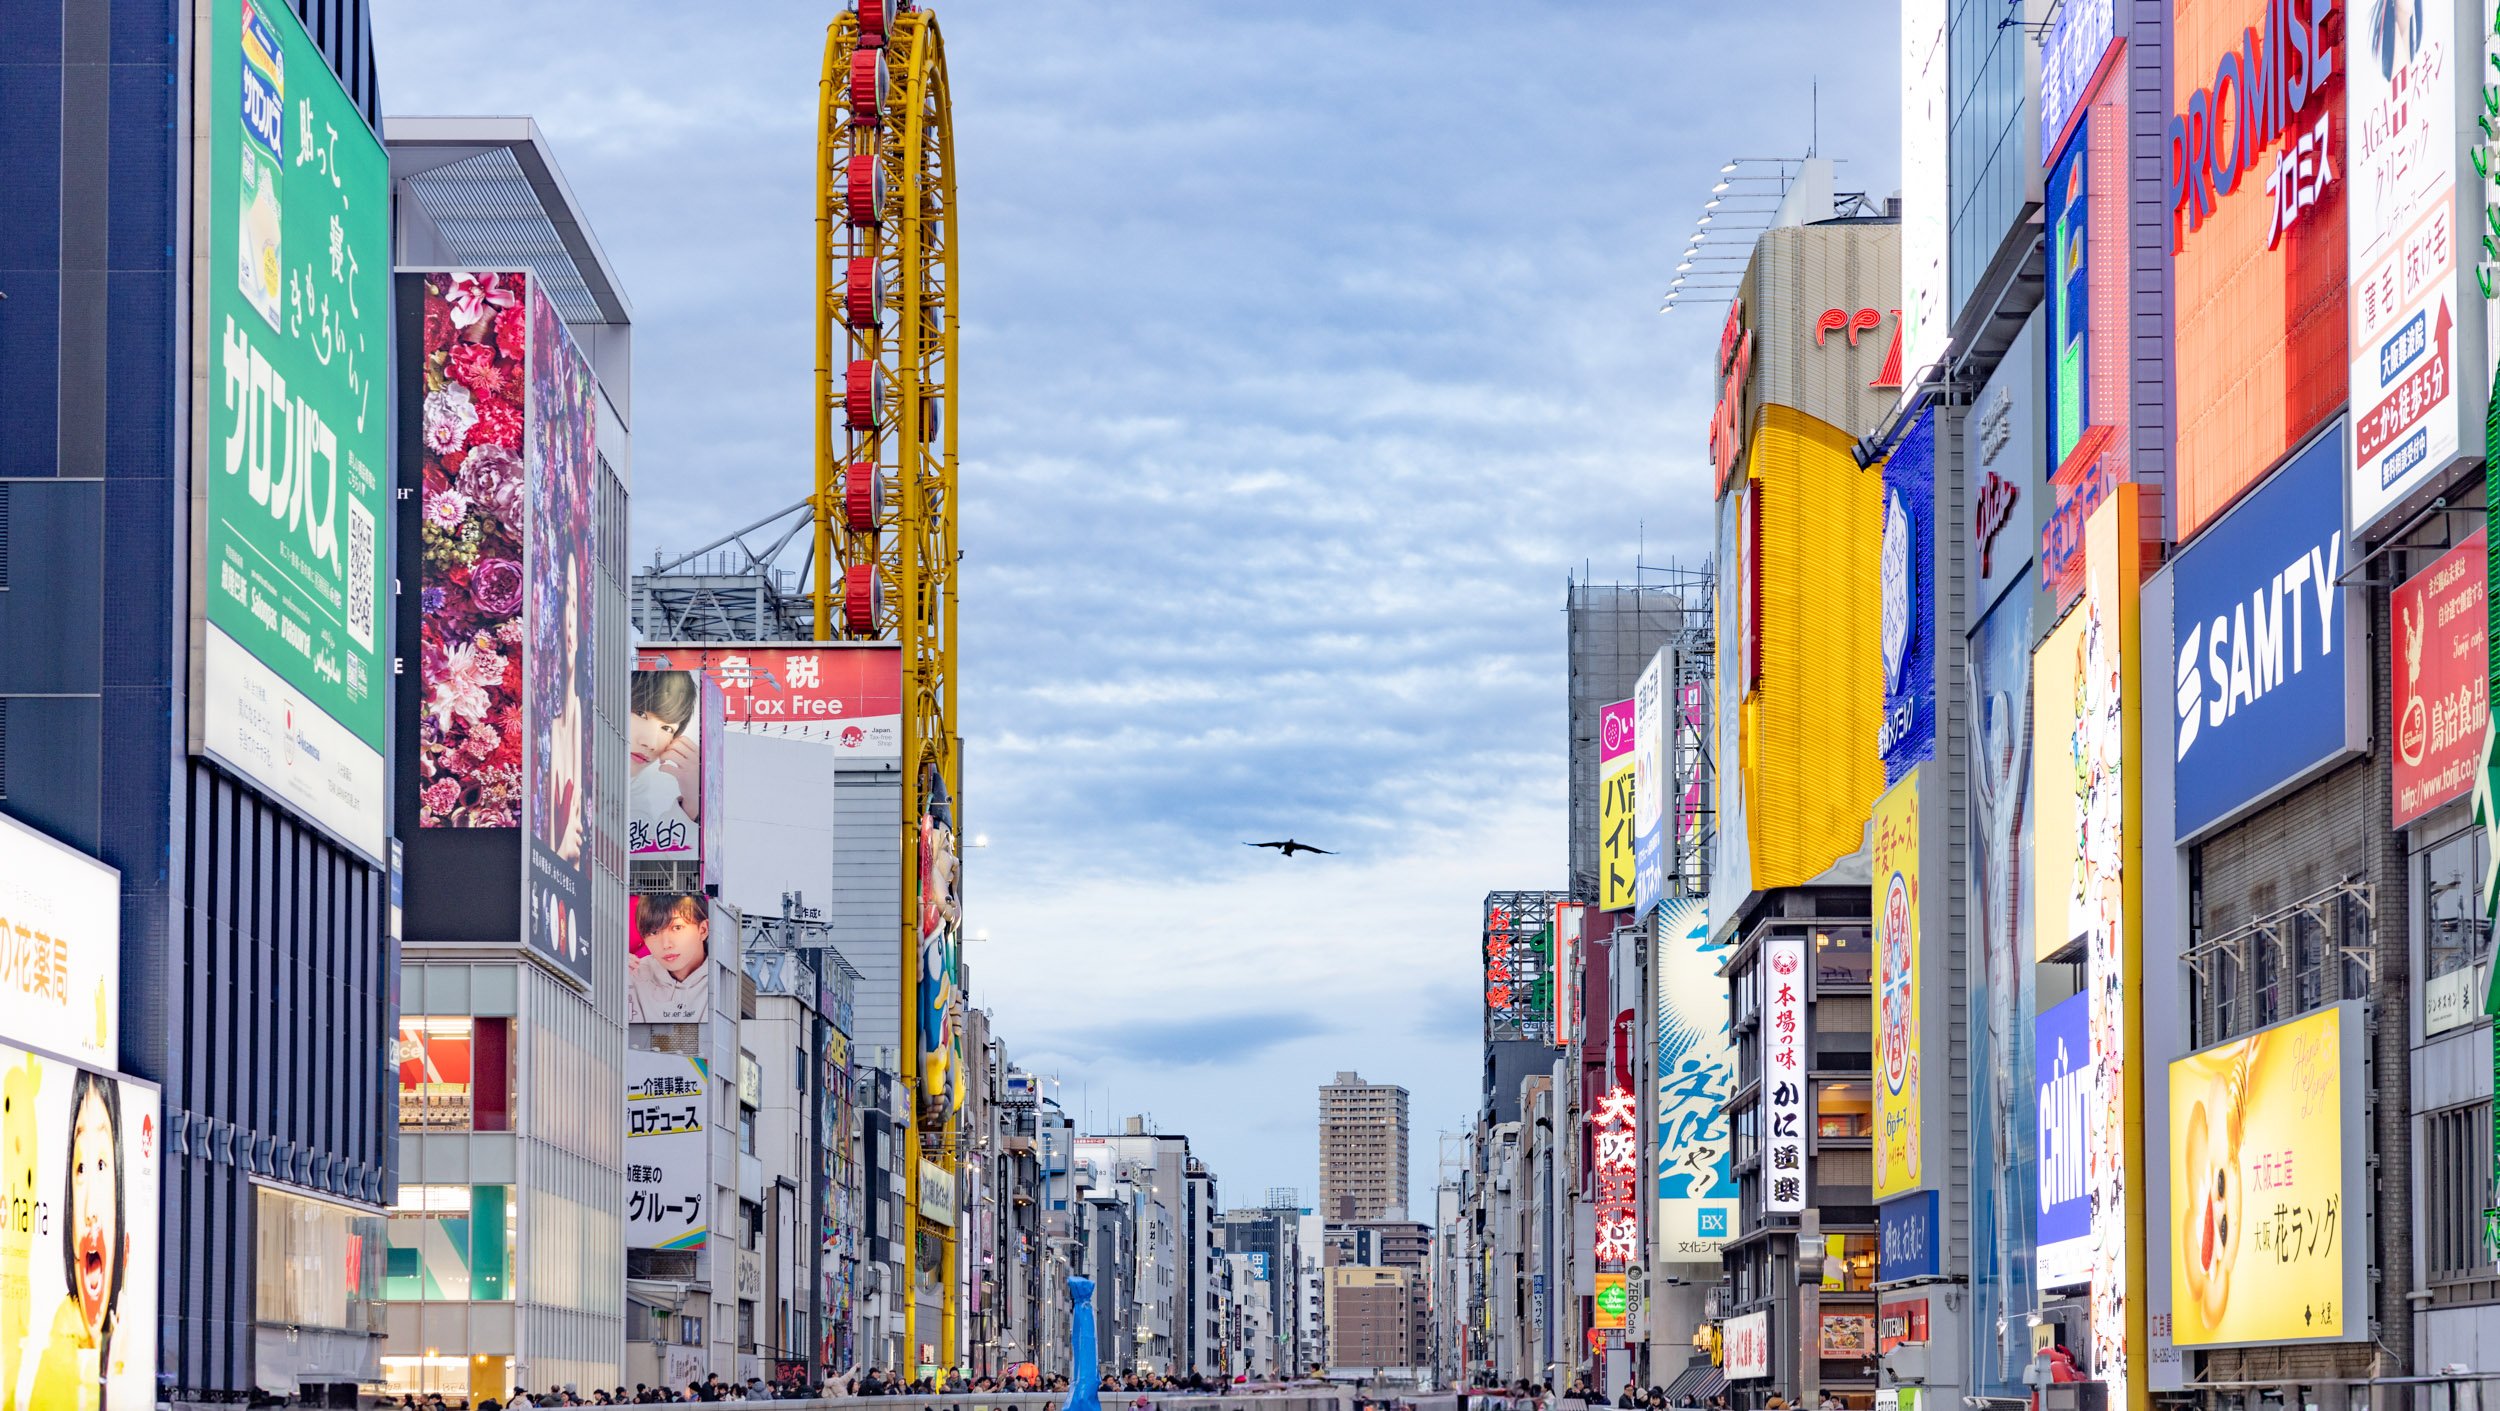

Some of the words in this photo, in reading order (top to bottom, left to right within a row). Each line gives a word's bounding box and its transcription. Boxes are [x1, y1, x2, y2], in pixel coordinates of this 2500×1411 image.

[2168, 0, 2333, 252] PROMISE
[2360, 97, 2391, 167] AGA
[2411, 41, 2446, 109] スキン
[2266, 110, 2333, 251] プロミス
[2376, 118, 2430, 213] クリニック
[2364, 263, 2394, 335] 薄毛
[2406, 212, 2447, 296] 抜け毛
[2381, 317, 2425, 382] 大阪難波院
[223, 313, 338, 578] サロンパス
[2361, 356, 2445, 456] ここから徒歩5分
[2382, 430, 2427, 487] 無料相談受付中
[1975, 471, 2018, 579] Glico
[718, 655, 821, 690] 免税
[2208, 529, 2342, 728] SAMTY
[745, 695, 785, 716] Tax
[792, 697, 843, 716] Free
[2430, 674, 2487, 755] 鳥治食品
[1605, 773, 1627, 903] バイト
[1486, 907, 1513, 1009] お好み焼
[1774, 982, 1797, 1071] 本場の味
[627, 1105, 700, 1135] ロデュース
[628, 1075, 698, 1097] ー・介護事業まで
[1592, 1085, 1637, 1262] 大阪王将
[1772, 1080, 1800, 1203] かに道楽
[2253, 1150, 2294, 1192] 大阪土産
[1701, 1213, 1725, 1231] BX
[2254, 1221, 2271, 1254] 大阪
[2274, 1193, 2340, 1266] 花ラング
[1628, 1282, 1639, 1312] ZERO
